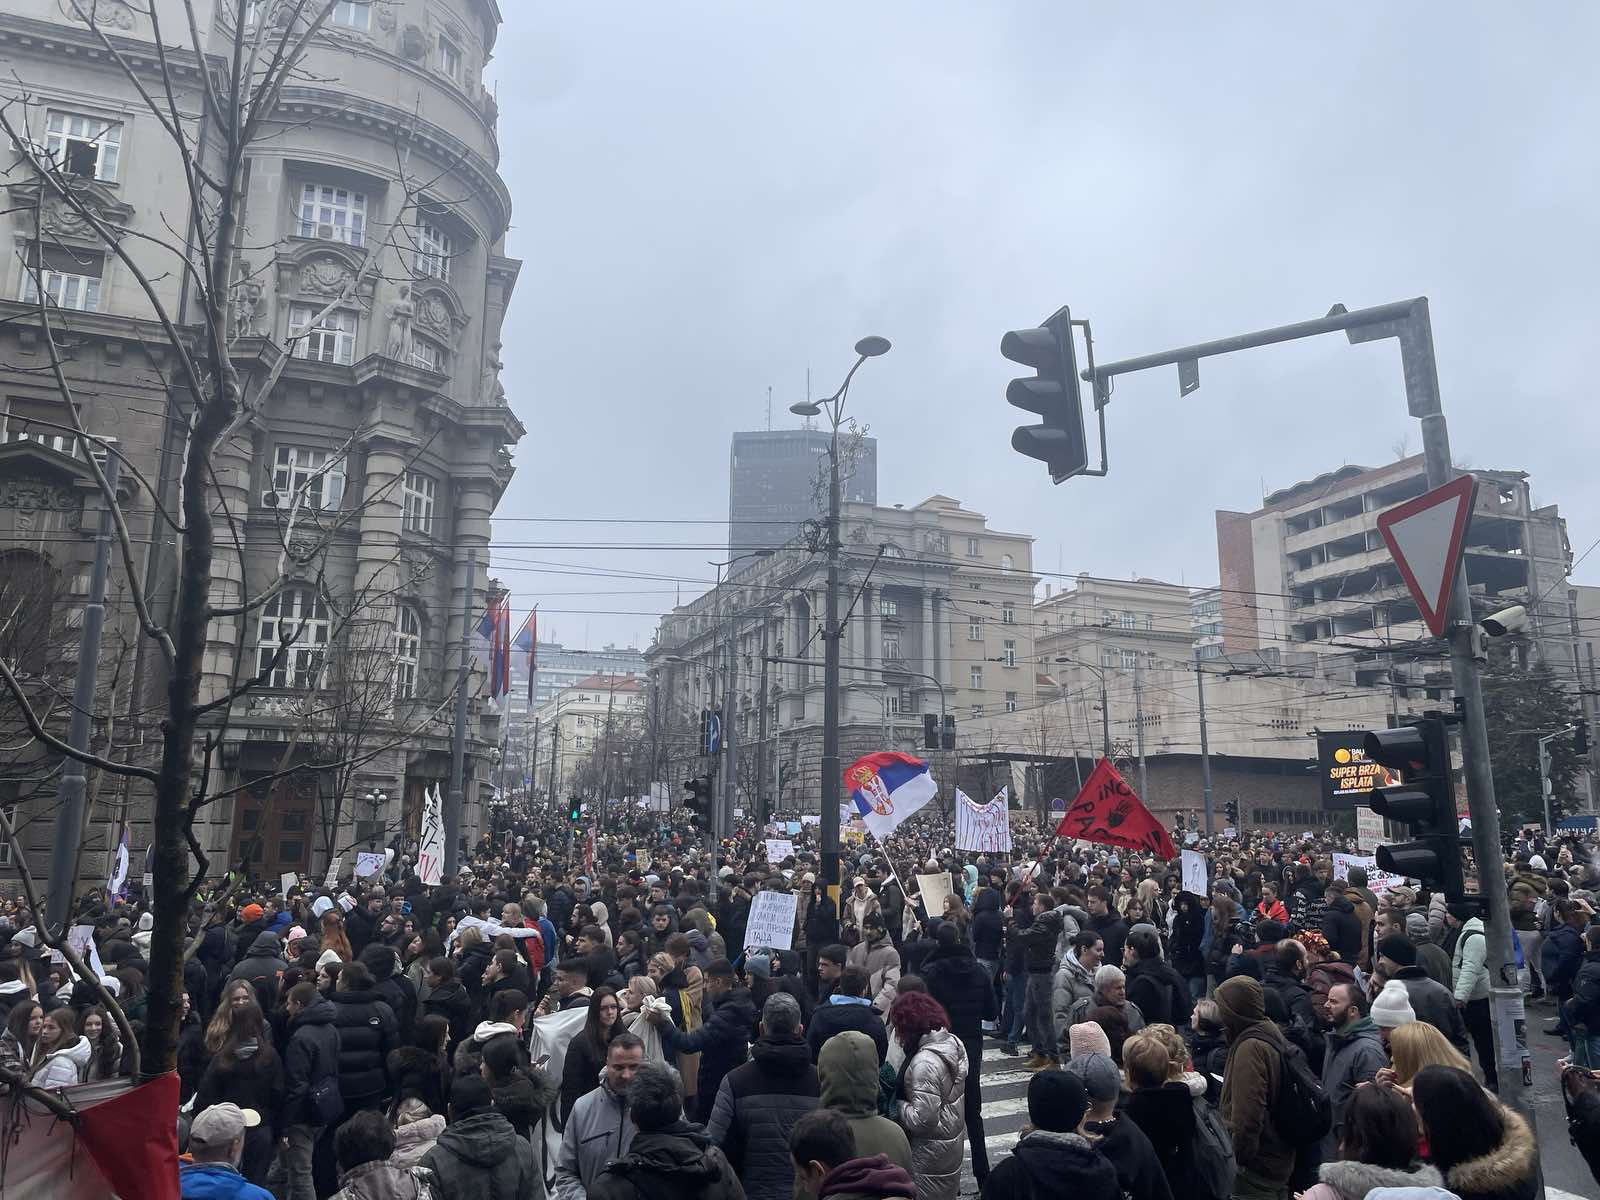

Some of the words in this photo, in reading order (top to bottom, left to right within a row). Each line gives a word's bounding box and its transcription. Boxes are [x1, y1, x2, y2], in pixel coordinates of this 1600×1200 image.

[1330, 767, 1357, 779] SUPER
[1358, 764, 1380, 775] BRZA
[1341, 776, 1373, 788] ISPLATA
